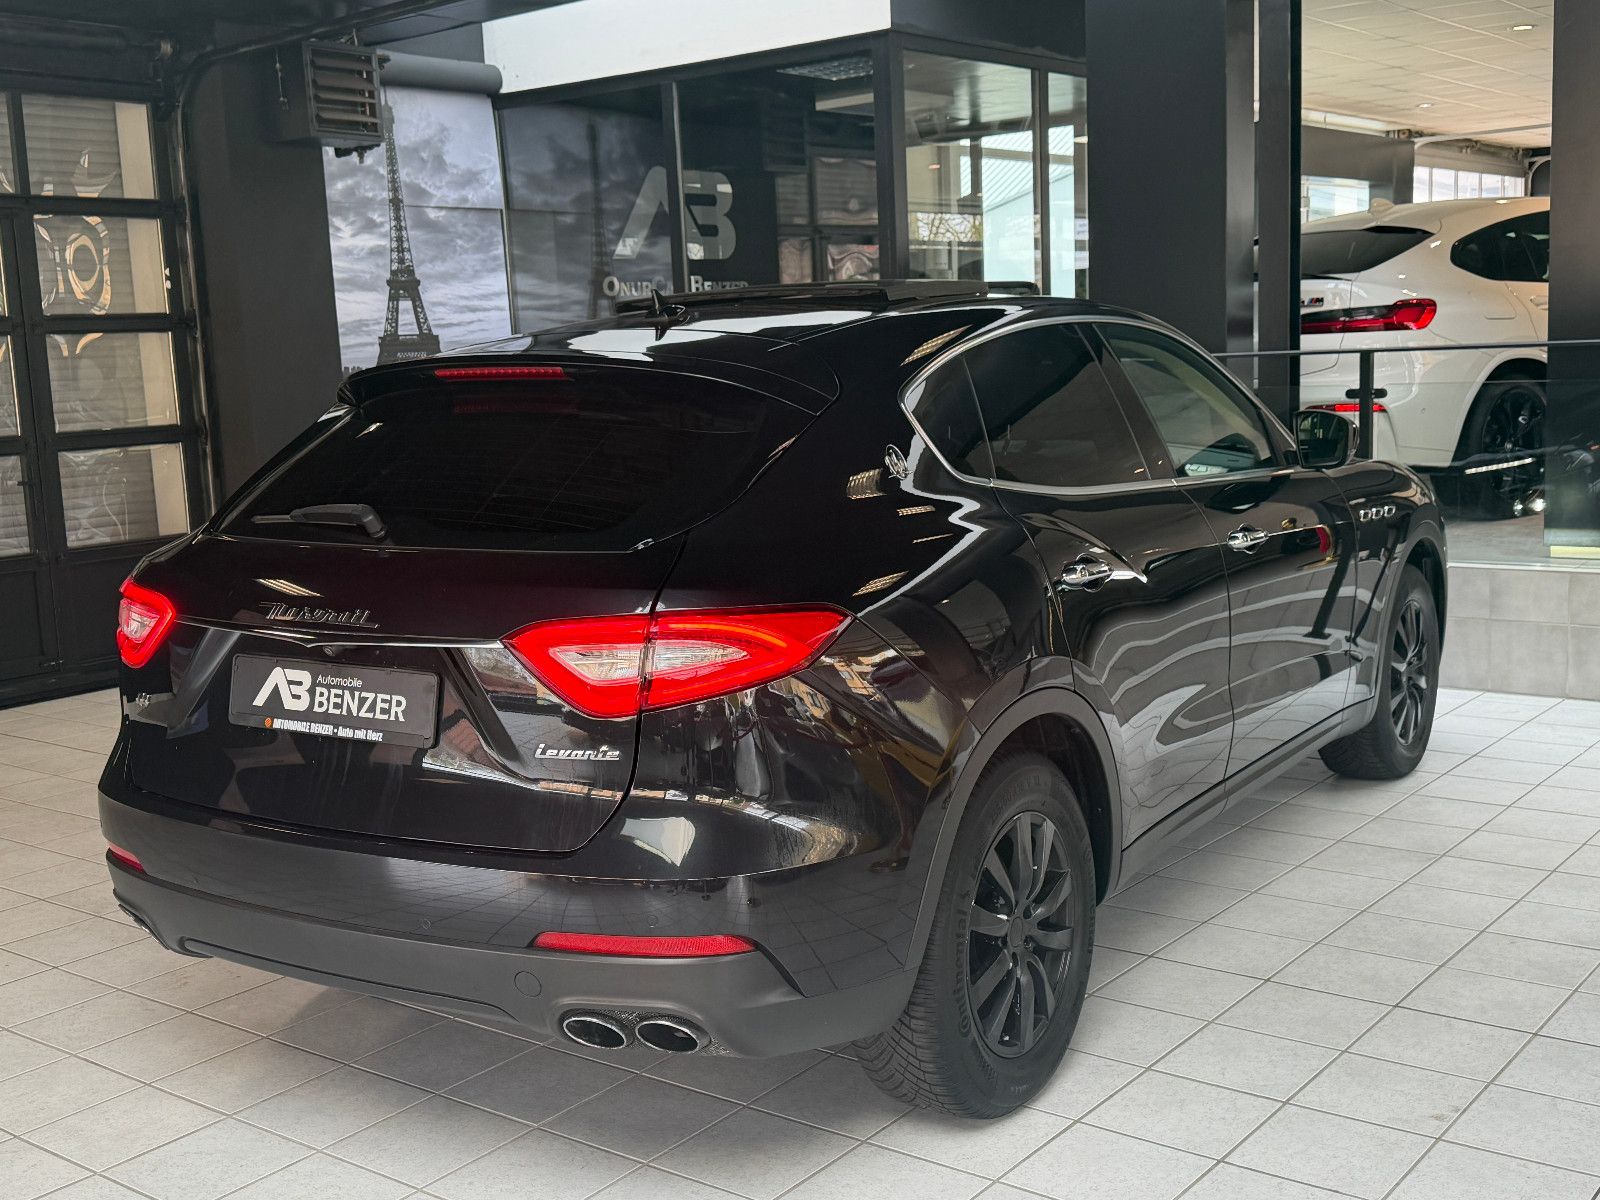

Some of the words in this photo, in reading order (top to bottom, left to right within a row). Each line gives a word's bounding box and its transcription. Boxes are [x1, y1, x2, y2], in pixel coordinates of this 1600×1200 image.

[252, 667, 312, 711] AB
[316, 674, 363, 688] Automobile
[313, 687, 407, 721] BENZER
[272, 718, 311, 734] AUTOMOBILE
[310, 722, 334, 736] BENZER
[337, 726, 354, 738] Auto
[354, 728, 367, 740] mit
[366, 730, 384, 742] Herz
[534, 743, 620, 760] Levante
